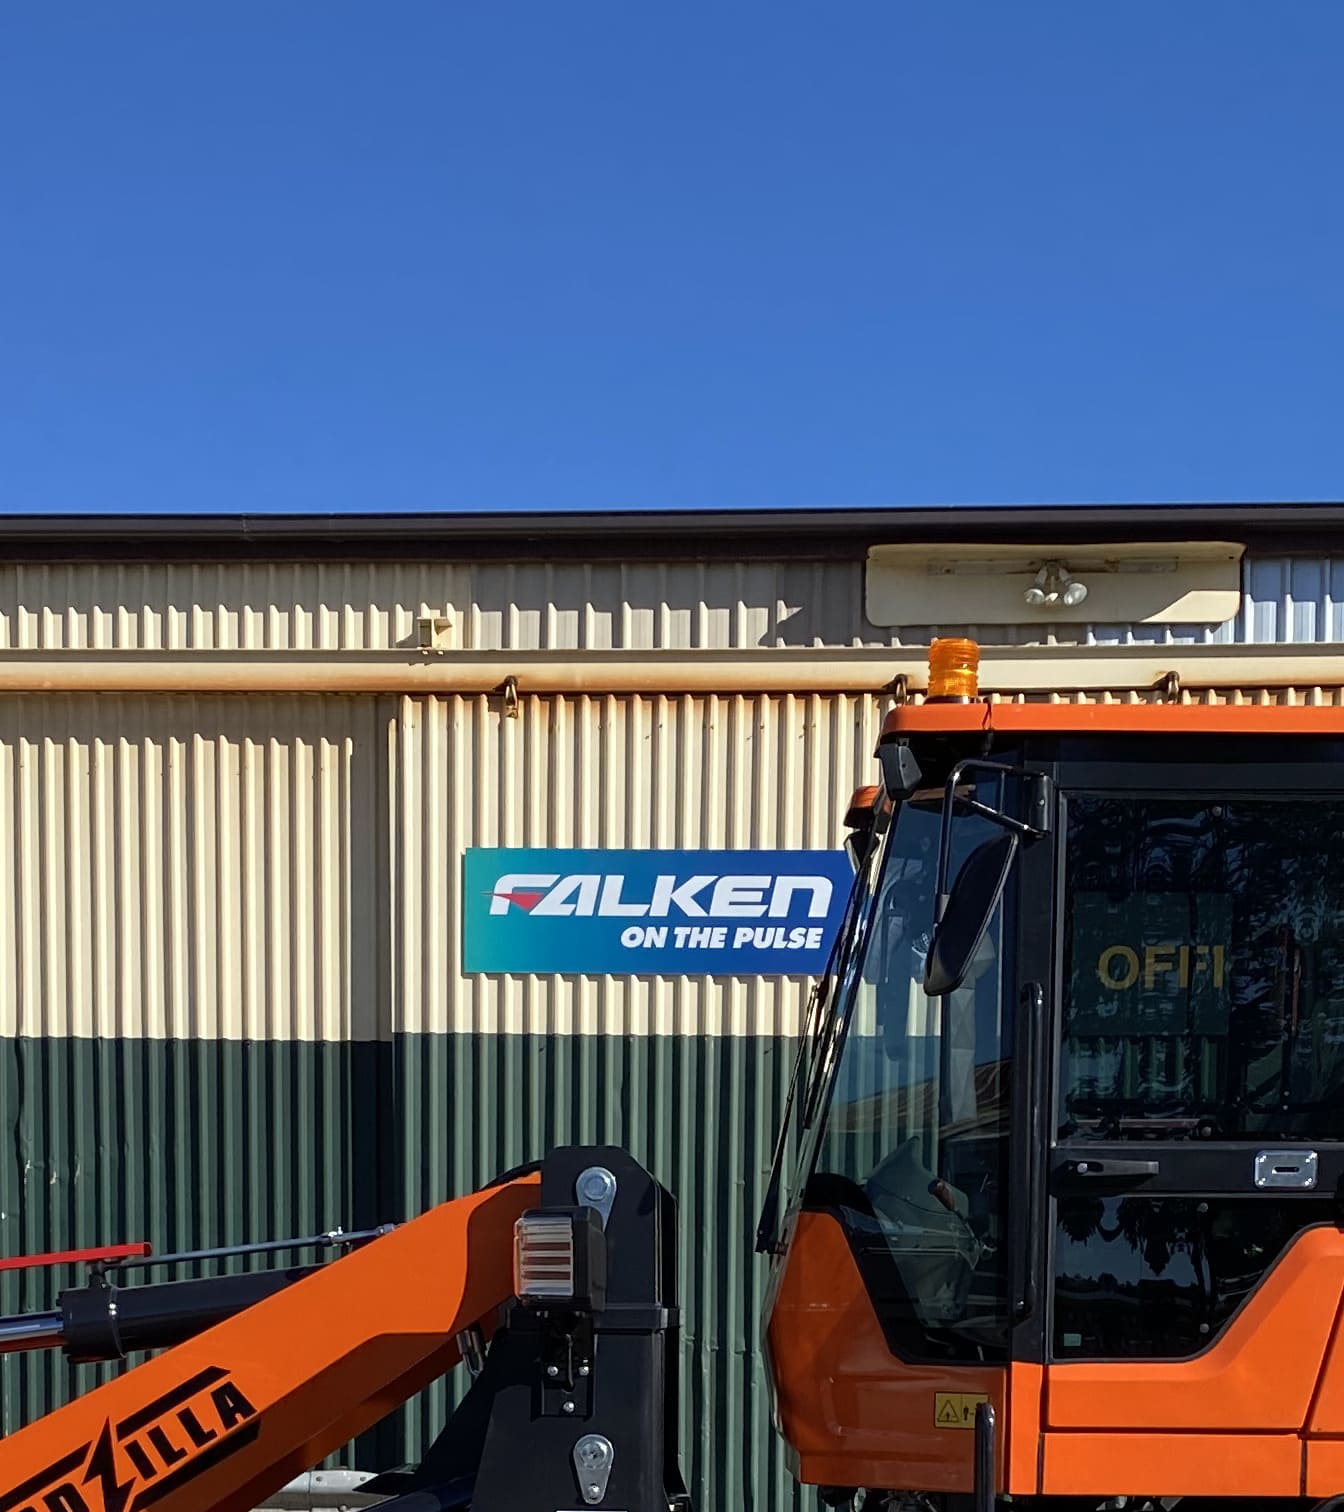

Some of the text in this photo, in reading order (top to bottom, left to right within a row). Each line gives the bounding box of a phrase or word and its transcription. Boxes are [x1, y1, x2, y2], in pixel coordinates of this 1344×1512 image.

[485, 873, 834, 918] FALKEN
[620, 926, 824, 950] ON THE PULSE
